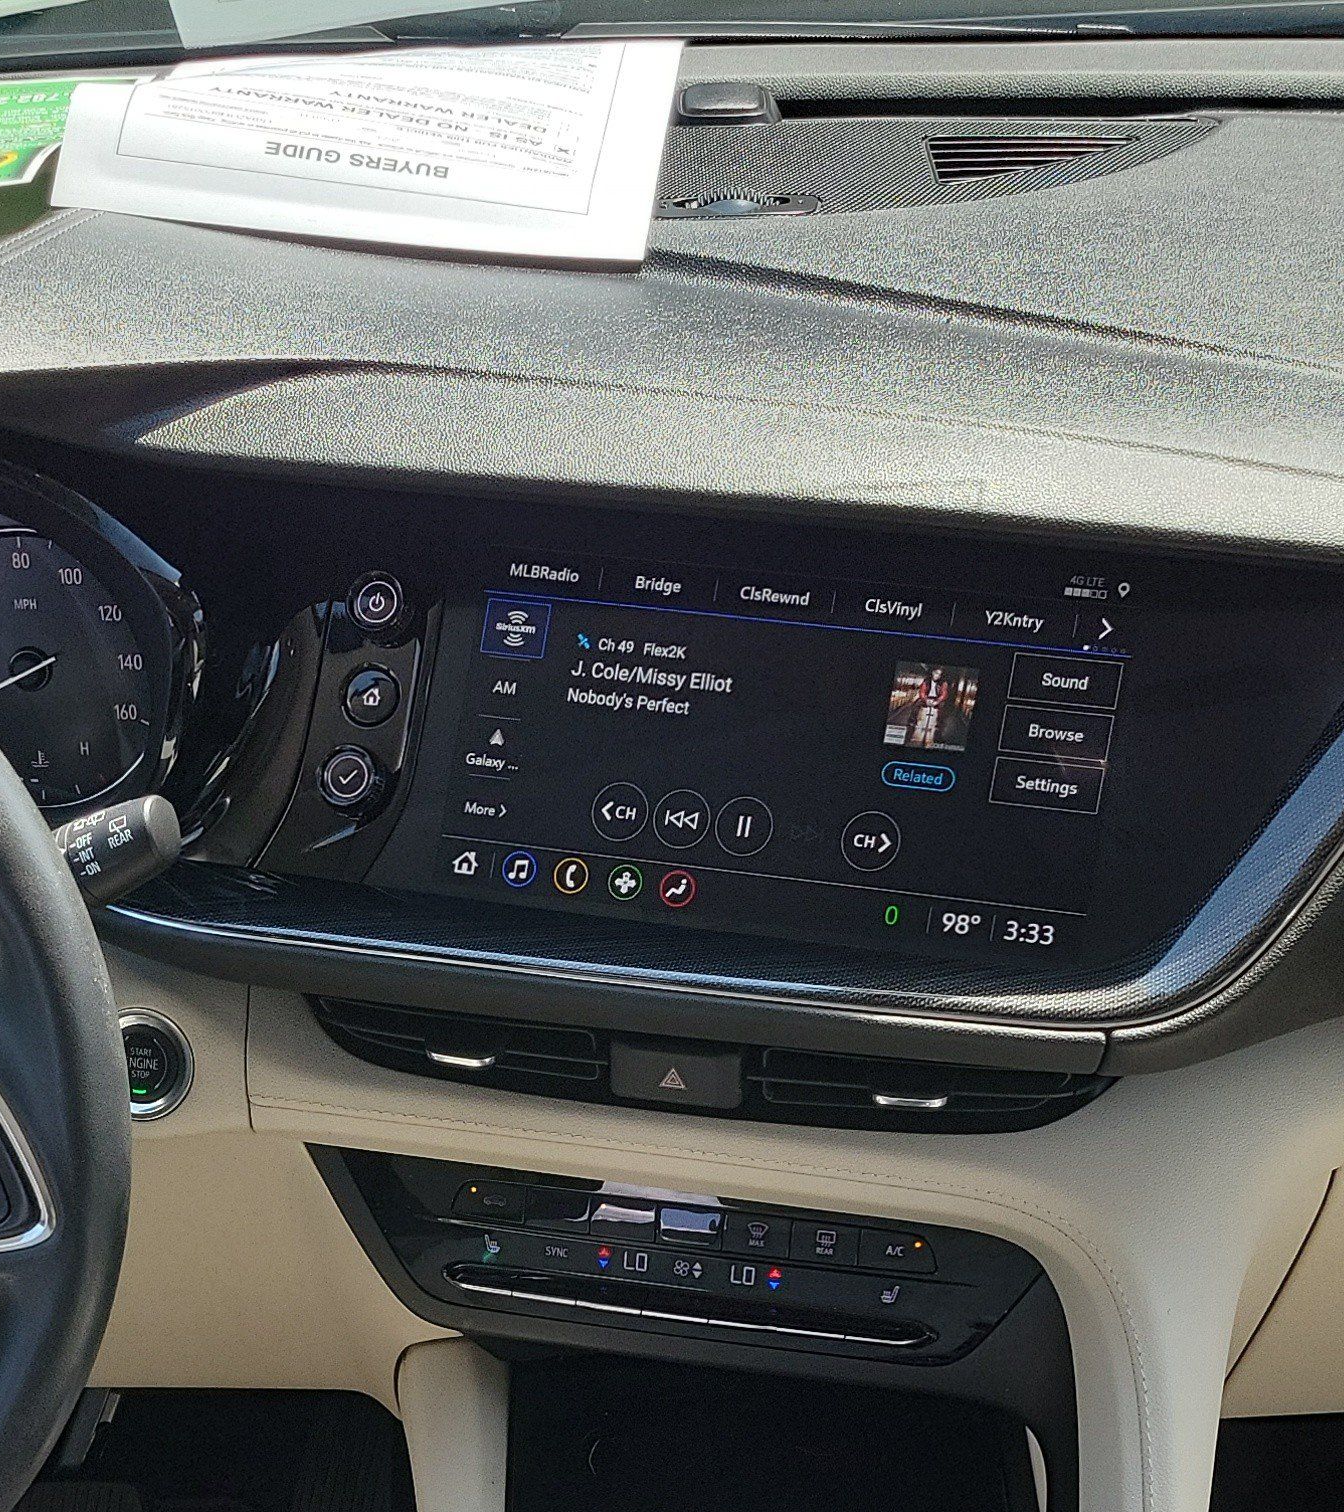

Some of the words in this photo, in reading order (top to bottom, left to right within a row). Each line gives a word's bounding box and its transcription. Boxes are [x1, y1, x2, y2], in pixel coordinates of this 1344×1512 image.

[264, 140, 342, 166] GUIDE
[348, 151, 451, 180] BUYERS
[11, 552, 30, 569] 80
[58, 568, 83, 585] 100
[509, 563, 580, 583] MLBRadio
[1070, 575, 1085, 585] 4G
[1086, 576, 1106, 588] LTE
[634, 575, 682, 594] Bridge
[14, 598, 37, 611] MPH
[740, 585, 811, 607] ClsRewnd
[98, 605, 122, 622] 120
[865, 597, 923, 620] ClsVinyl
[985, 609, 1044, 633] Y2Kntry
[598, 637, 616, 652] Ch
[618, 639, 634, 655] 49
[643, 641, 687, 660] Flex2K
[117, 654, 143, 671] 140
[571, 660, 587, 678] J.
[591, 662, 687, 691] Cole/Missy
[689, 673, 733, 694] Elliot
[1041, 672, 1089, 691] Sound
[492, 680, 517, 696] AM
[567, 687, 634, 711] Nobody's
[637, 696, 690, 716] Perfect
[114, 704, 137, 721] 160
[1028, 724, 1084, 743] Browse
[80, 741, 90, 756] H
[465, 752, 505, 771] Galaxy
[893, 767, 943, 787] Related
[1015, 775, 1078, 798] Settings
[464, 802, 496, 818] More
[616, 805, 637, 820] CH
[107, 829, 134, 849] REAR
[853, 833, 876, 850] CH
[884, 905, 899, 925] 0
[941, 912, 982, 935] 98°
[1003, 921, 1055, 946] 3:33
[130, 1046, 152, 1057] START
[128, 1056, 159, 1070] NGINE
[131, 1070, 150, 1079] STOP
[545, 1245, 569, 1259] SYNC
[815, 1246, 834, 1256] REAR
[885, 1245, 905, 1257] A/C
[623, 1250, 648, 1272] LO
[730, 1264, 756, 1286] LO
